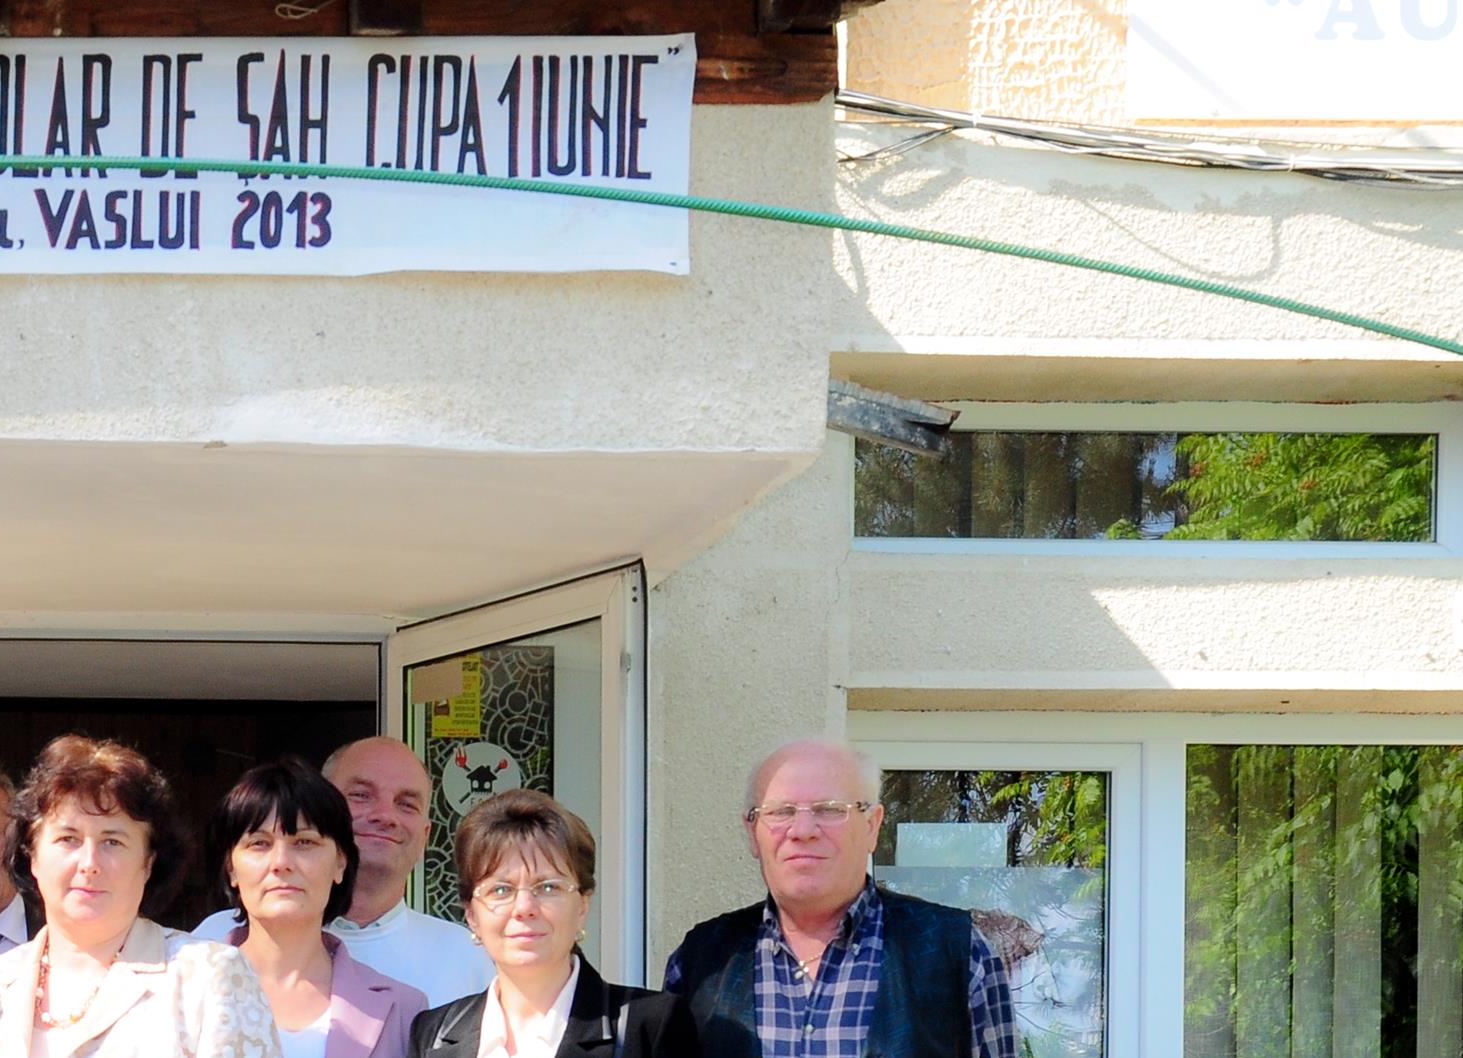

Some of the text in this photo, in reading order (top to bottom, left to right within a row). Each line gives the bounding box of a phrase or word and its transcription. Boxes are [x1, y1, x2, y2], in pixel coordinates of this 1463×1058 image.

[139, 52, 203, 179] DE
[366, 53, 488, 177] CUPA
[33, 188, 202, 250] VASLUI
[231, 189, 332, 250] 2013
